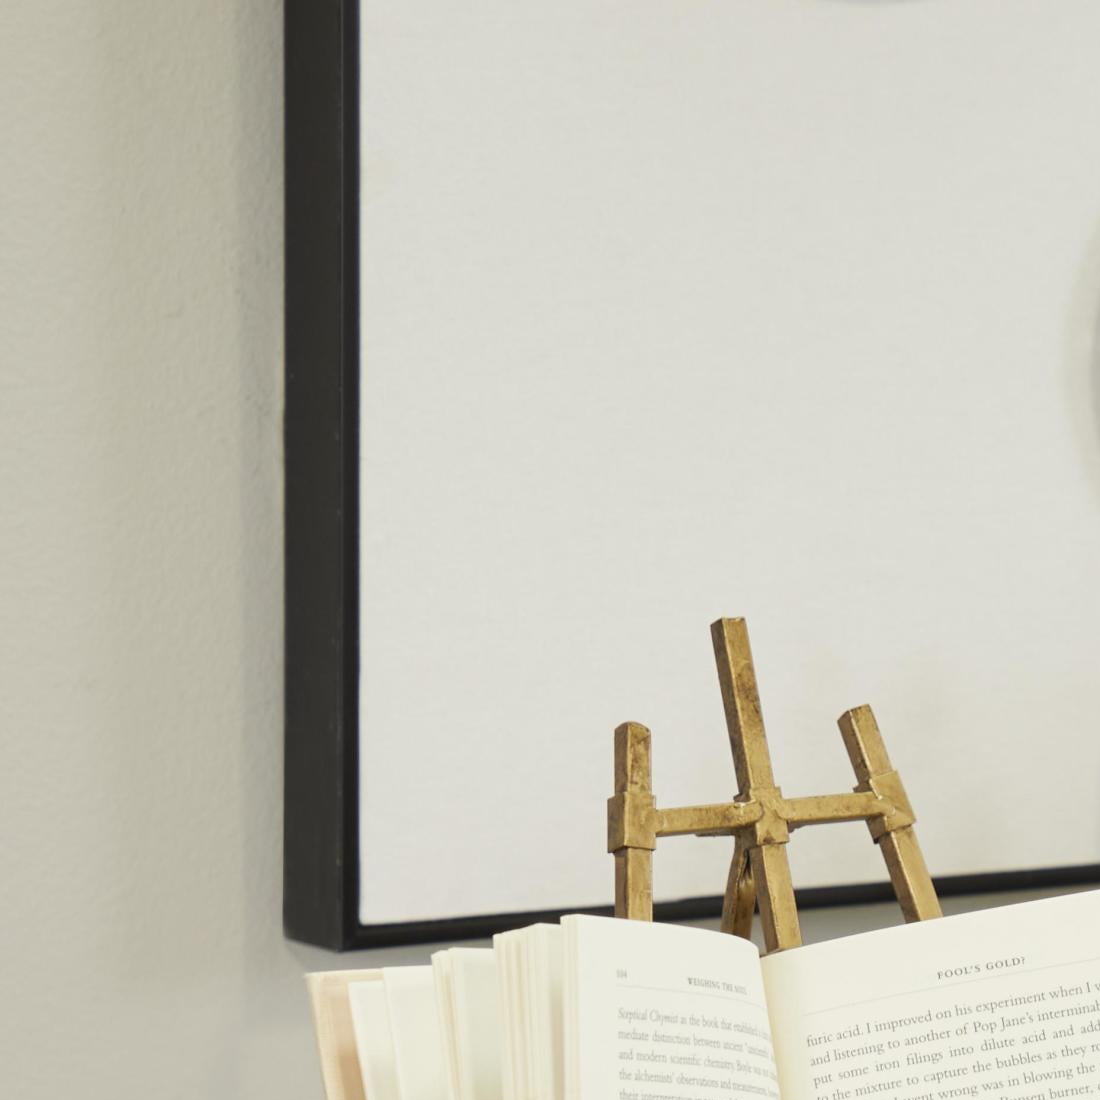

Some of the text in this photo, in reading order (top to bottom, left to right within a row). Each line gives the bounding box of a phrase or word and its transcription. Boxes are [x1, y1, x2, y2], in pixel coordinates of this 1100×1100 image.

[936, 956, 1026, 980] FOOL'S GOLD?
[806, 1031, 833, 1048] furic
[835, 1024, 864, 1041] acid.
[874, 1009, 933, 1033] improved
[935, 1009, 953, 1021] on
[954, 1004, 973, 1017] his
[975, 992, 1047, 1014] experiment
[1048, 985, 1084, 1000] when
[810, 1050, 831, 1067] and
[832, 1042, 886, 1062] listening
[887, 1039, 901, 1050] to
[904, 1028, 952, 1047] another
[954, 1022, 970, 1037] of
[972, 1020, 998, 1035] Pop
[999, 1011, 1035, 1033] Jane's
[813, 1073, 833, 1090] put
[837, 1066, 869, 1080] some
[874, 1059, 901, 1073] iron
[906, 1051, 944, 1066] filings
[948, 1045, 975, 1059] into
[980, 1037, 1016, 1052] dilute
[1021, 1028, 1047, 1045] acid
[1049, 1023, 1075, 1040] and
[854, 1079, 903, 1097] mixture
[905, 1076, 920, 1086] to
[923, 1066, 969, 1085] capture
[972, 1060, 993, 1074] the
[994, 1051, 1044, 1070] bubbles
[1045, 1050, 1058, 1061] as
[1060, 1044, 1087, 1059] they
